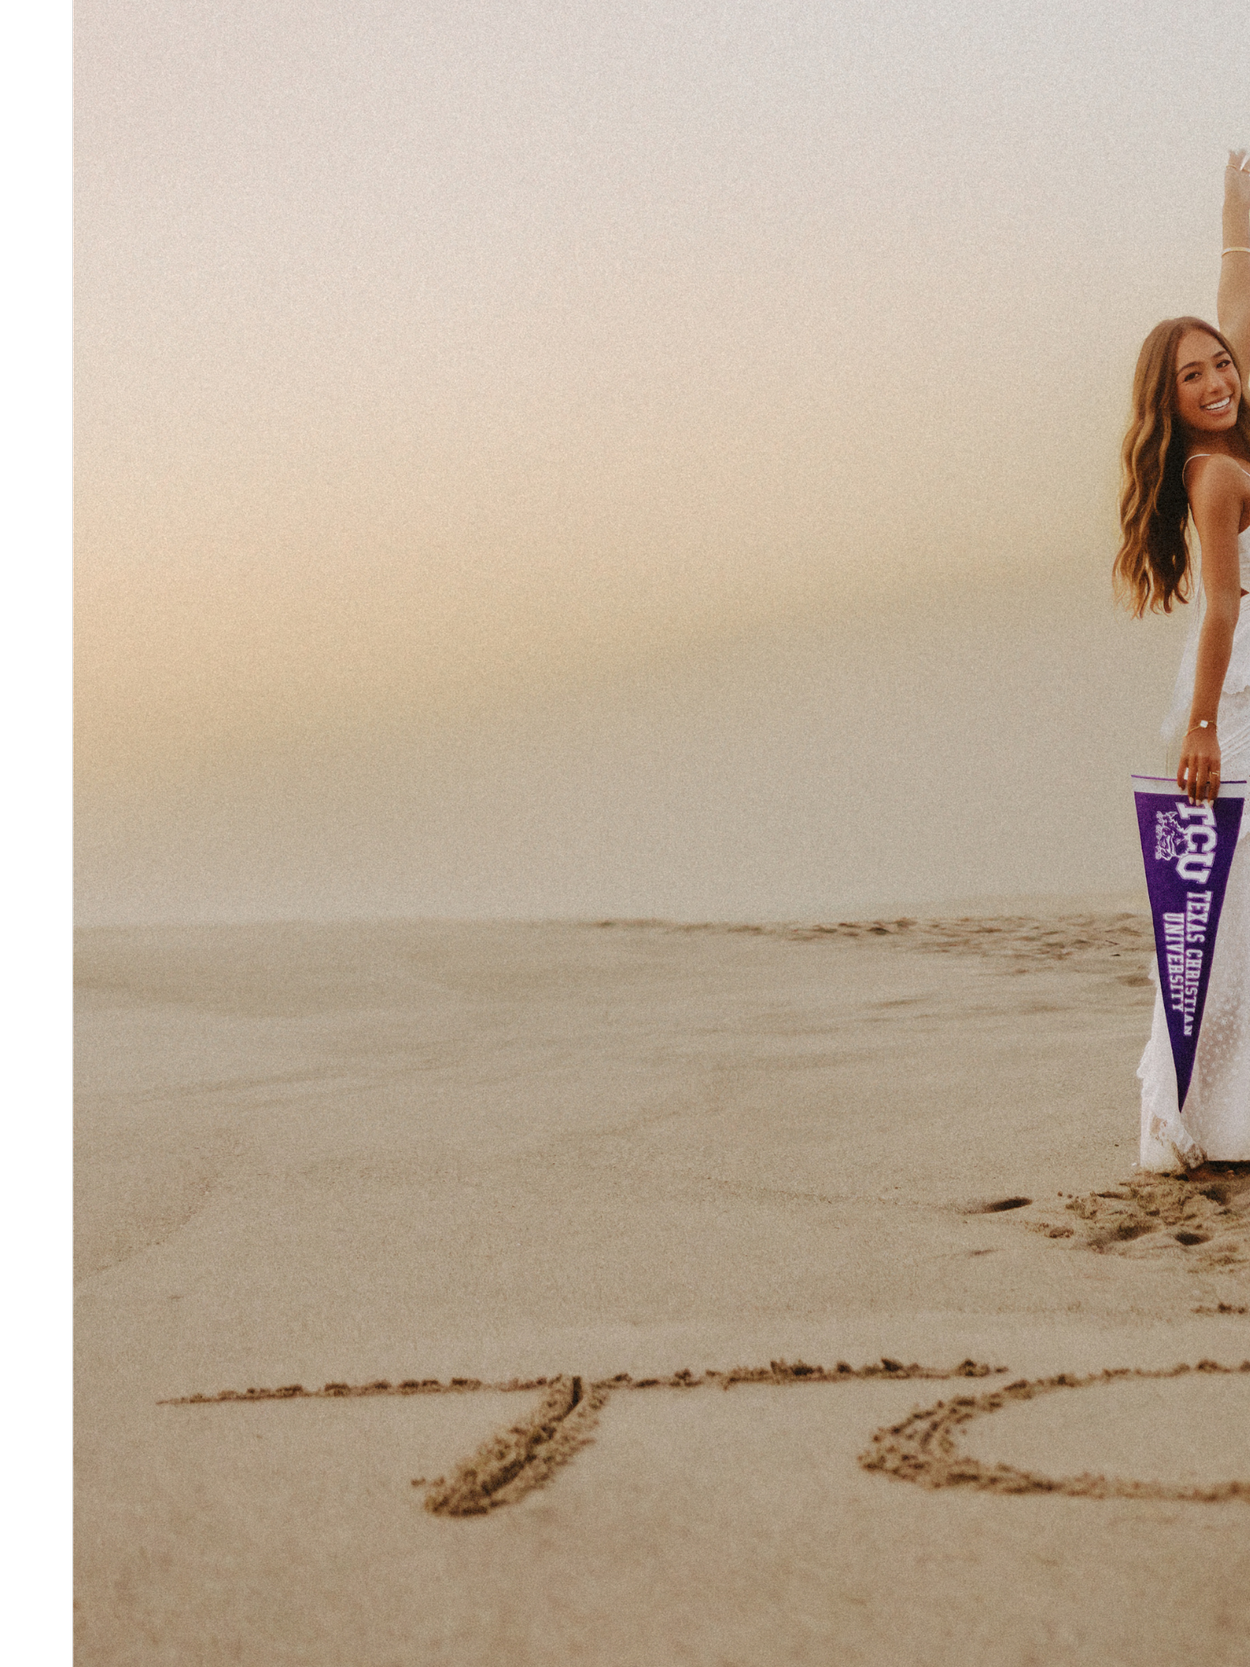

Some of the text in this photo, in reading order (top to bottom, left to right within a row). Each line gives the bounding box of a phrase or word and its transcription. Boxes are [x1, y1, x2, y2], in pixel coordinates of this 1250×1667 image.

[1176, 800, 1217, 884] TCU
[1163, 912, 1185, 1013] UNIVERSITY
[1184, 890, 1212, 1036] TEXAS CHRISTIAN
